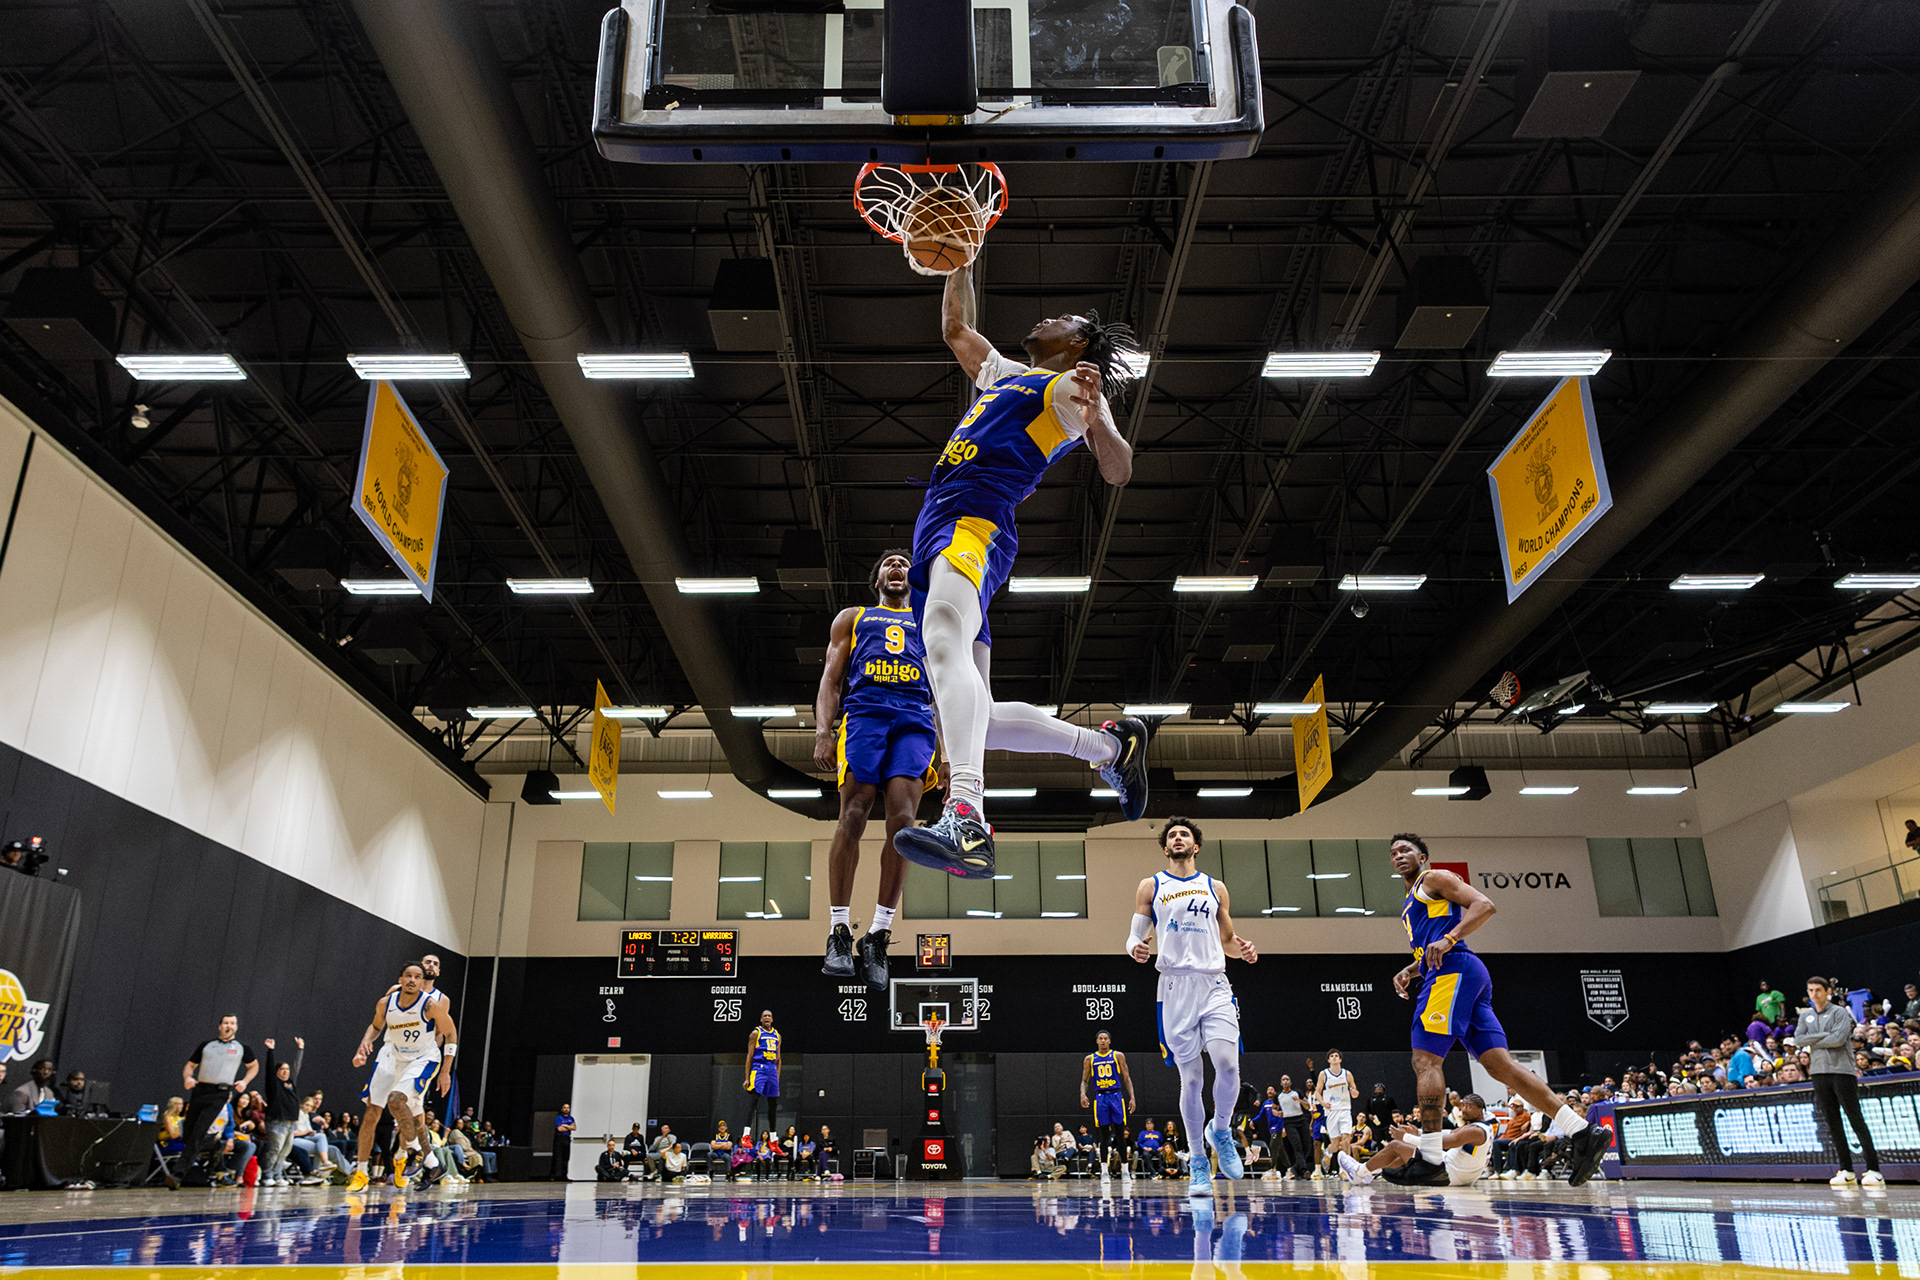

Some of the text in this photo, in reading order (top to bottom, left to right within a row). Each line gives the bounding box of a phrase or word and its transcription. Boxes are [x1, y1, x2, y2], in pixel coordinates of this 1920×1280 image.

[957, 394, 1000, 430] 5
[364, 494, 377, 514] 1951
[1581, 493, 1596, 515] 1954
[374, 477, 424, 553] WORLD CHAMPIONS
[1518, 478, 1584, 554] WORLD CHAMPIONS
[416, 561, 428, 579] 1952
[1514, 561, 1528, 580] 1953
[885, 625, 905, 654] 9
[865, 659, 920, 681] bibigo
[873, 674, 899, 683] 비비고
[1478, 872, 1572, 889] TOYOTA
[1159, 889, 1209, 906] WARRIORS
[1187, 898, 1210, 919] 44
[628, 932, 652, 940] LAKERS
[671, 932, 697, 944] 7:22
[702, 932, 734, 940] WARRIORS
[625, 943, 645, 955] 101
[716, 943, 732, 955] 95
[922, 947, 945, 965] 21
[724, 962, 731, 972] 0
[711, 986, 747, 994] GOODRICH
[838, 985, 868, 994] WORTHY
[959, 985, 994, 994] JOHSON
[1072, 984, 1127, 993] ABDUL-JABBAR
[1320, 983, 1373, 992] CHAMBERLAIN
[18, 1004, 42, 1015] BAY
[713, 999, 743, 1022] 25
[838, 999, 868, 1021] 42
[962, 998, 991, 1021] 32
[1086, 998, 1114, 1020] 33
[1337, 996, 1362, 1020] 13
[403, 1029, 421, 1043] 99
[766, 1039, 777, 1051] 15
[1097, 1064, 1113, 1078] 00
